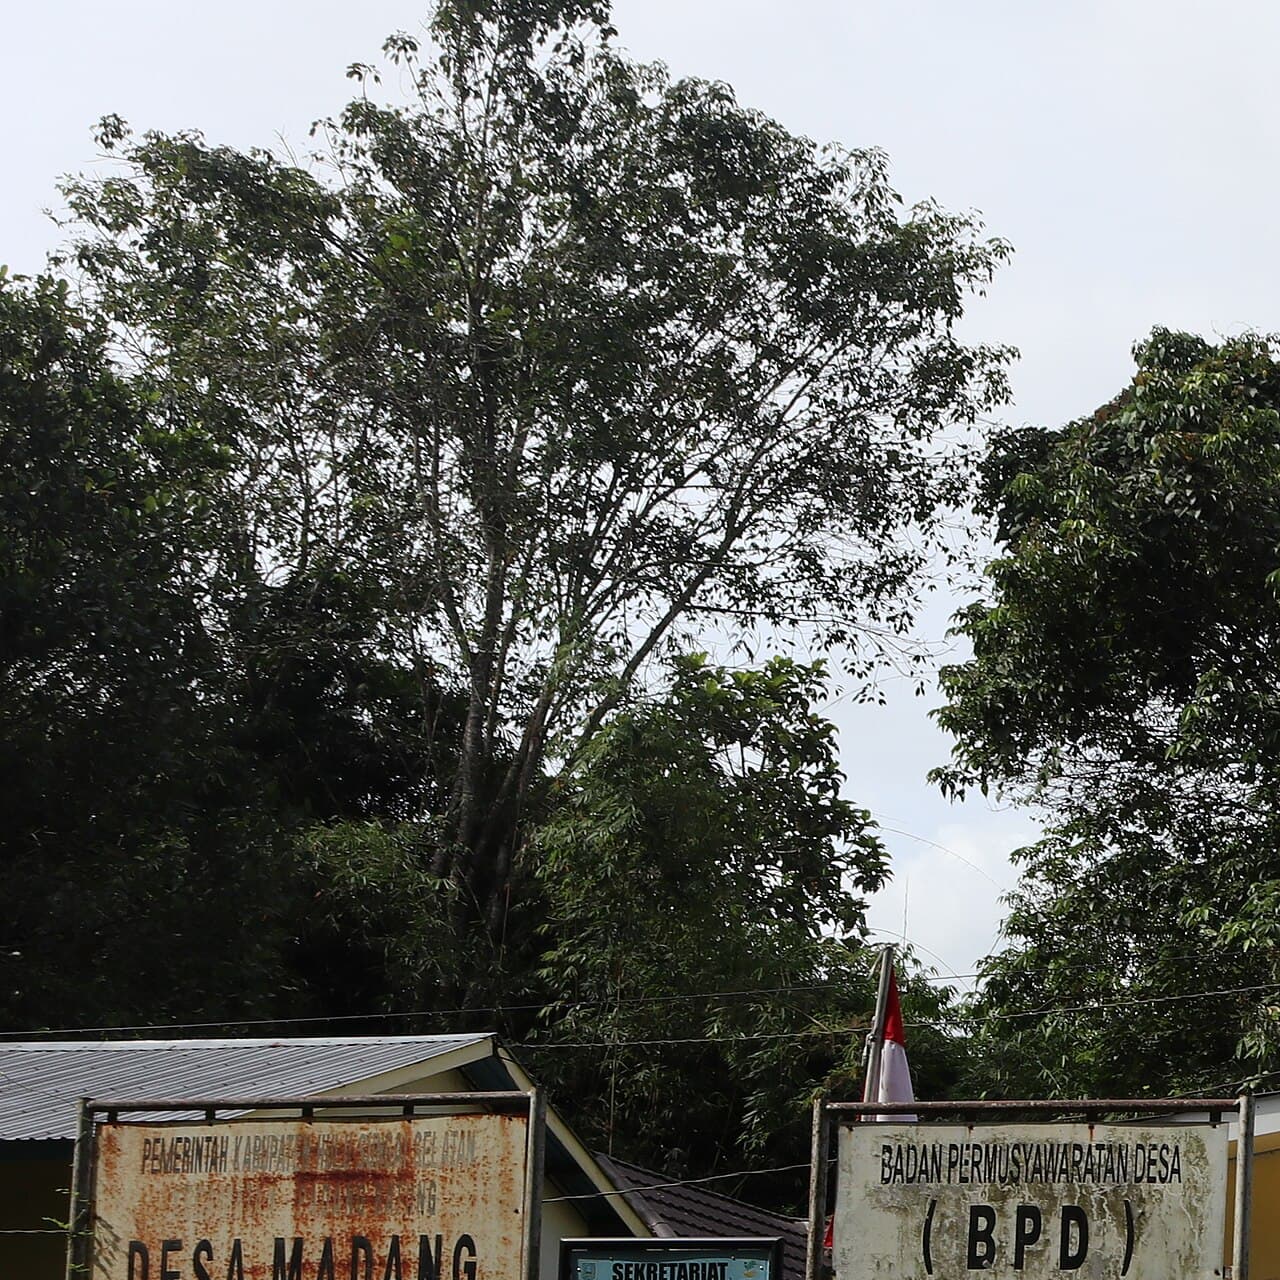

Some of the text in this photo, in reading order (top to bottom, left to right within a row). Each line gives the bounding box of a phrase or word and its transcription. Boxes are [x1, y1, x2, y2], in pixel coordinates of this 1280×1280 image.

[142, 1135, 229, 1175] PEMERINTAH
[881, 1143, 1182, 1185] BADAN PERMUSYAWARATAN DESA
